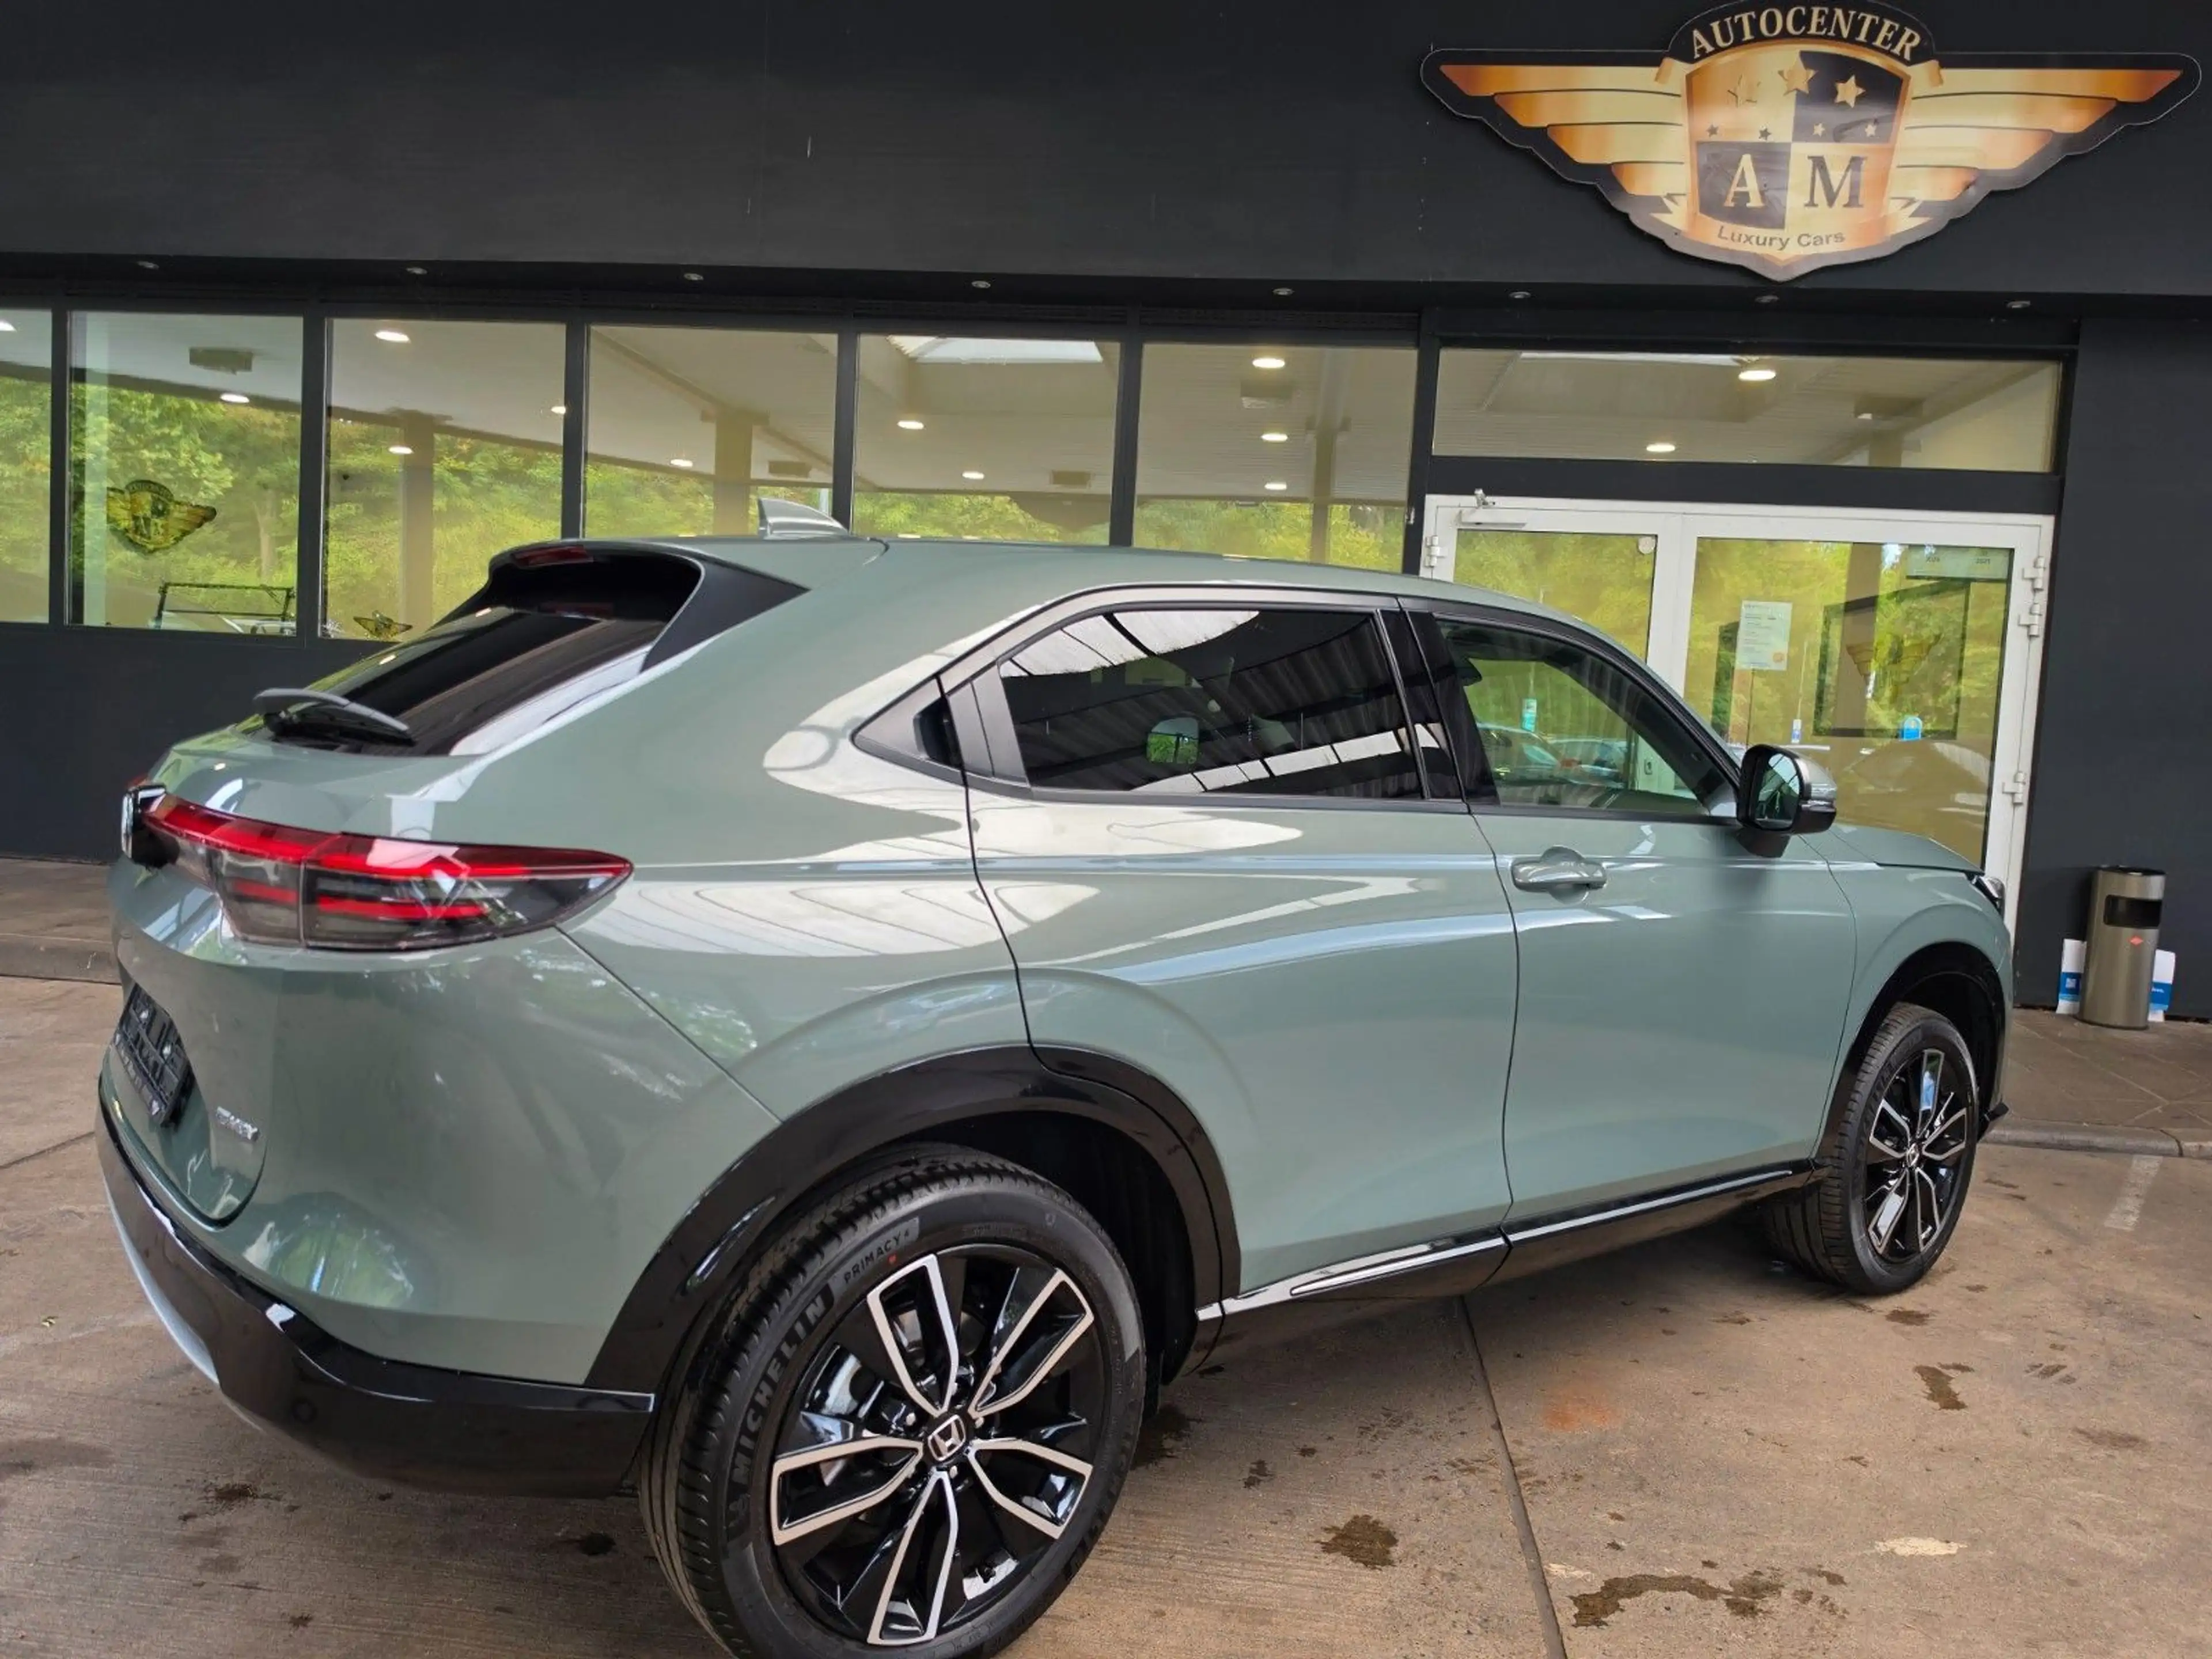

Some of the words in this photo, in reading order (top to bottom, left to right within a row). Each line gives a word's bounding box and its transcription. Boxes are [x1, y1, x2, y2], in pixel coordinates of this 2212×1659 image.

[1693, 6, 1921, 61] AUTOCENTER
[1724, 153, 1766, 208] A
[1804, 155, 1868, 209] M
[1717, 225, 1790, 251] Luxury
[1797, 232, 1846, 248] Cars
[843, 1230, 901, 1284] PRIMACY
[731, 1293, 827, 1485] MICHELIN
